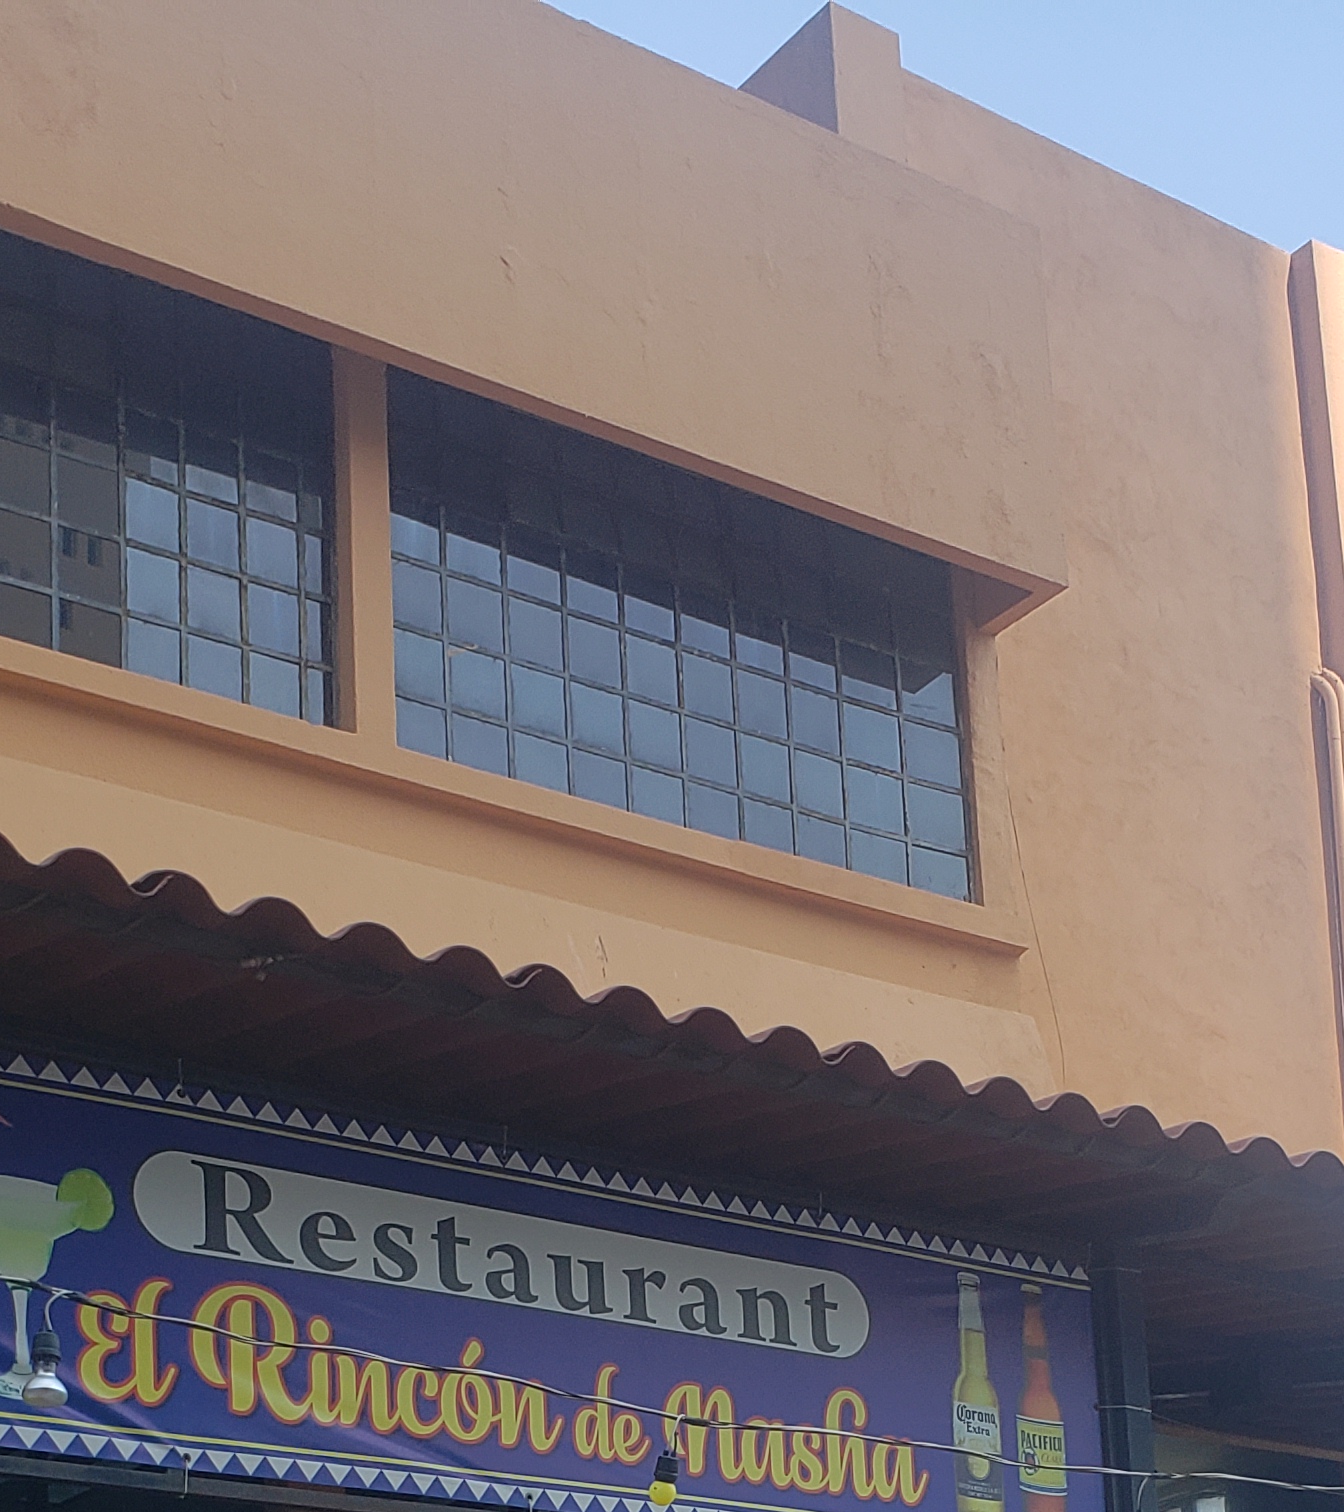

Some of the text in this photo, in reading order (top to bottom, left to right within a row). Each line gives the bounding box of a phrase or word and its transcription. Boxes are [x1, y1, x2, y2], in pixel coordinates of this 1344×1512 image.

[190, 1158, 842, 1354] Restaurant
[74, 1276, 930, 1507] El Rincón de Nasha
[956, 1403, 998, 1428] Corona
[966, 1421, 991, 1437] Extra
